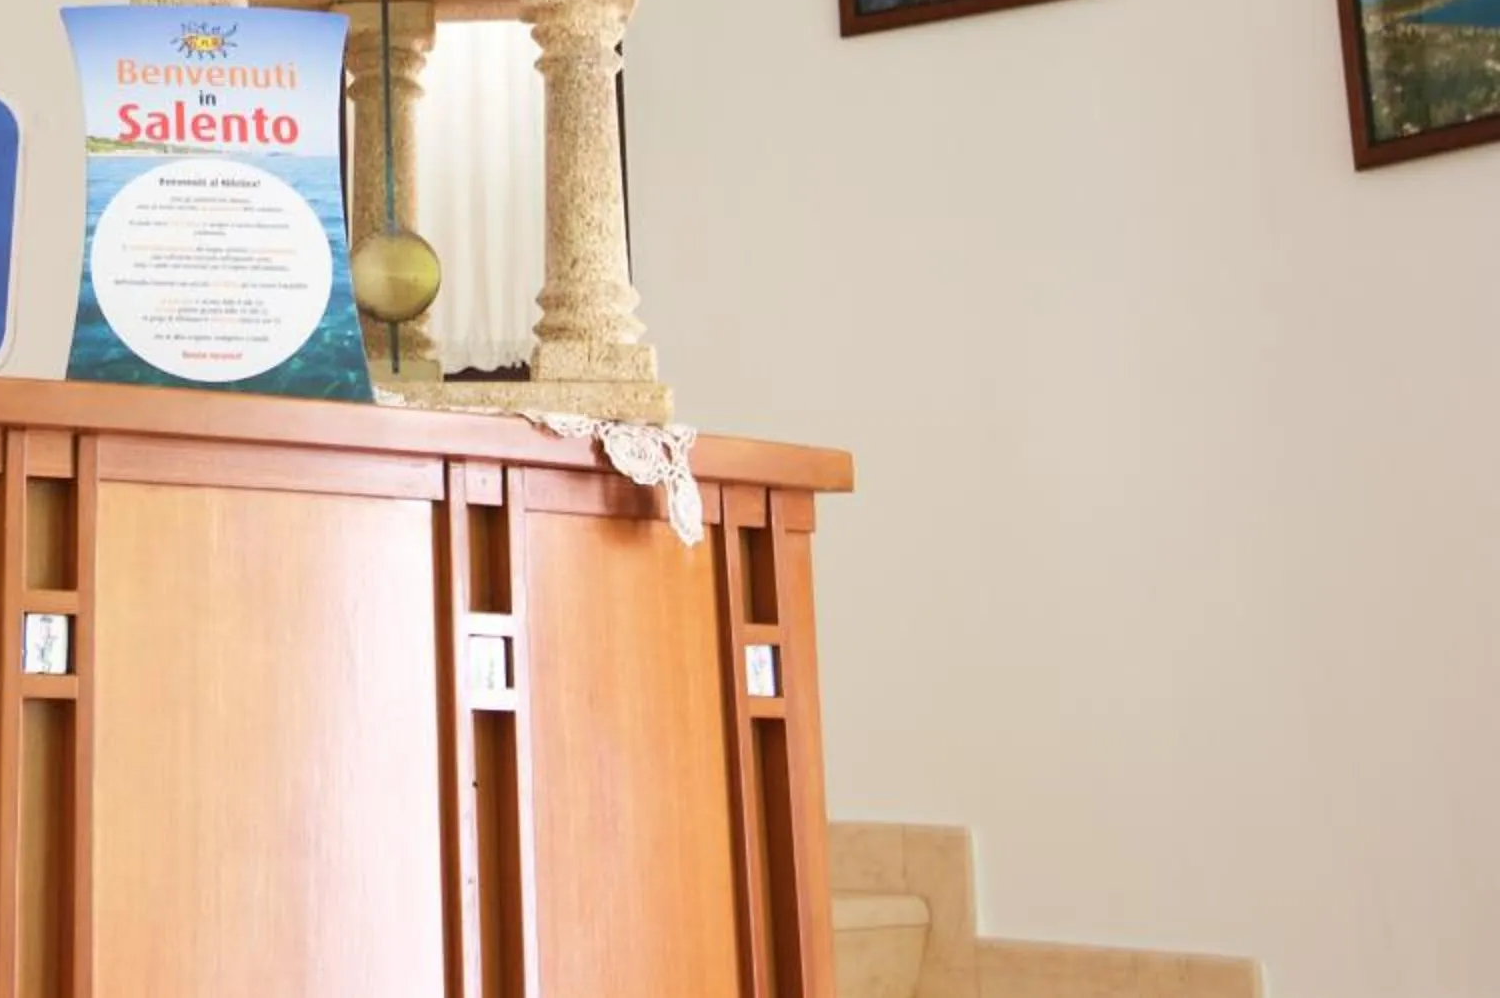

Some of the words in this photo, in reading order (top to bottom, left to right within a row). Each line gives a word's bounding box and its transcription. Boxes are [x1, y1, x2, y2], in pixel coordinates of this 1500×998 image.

[116, 57, 298, 90] Benvenuti
[198, 90, 217, 106] in
[117, 100, 300, 145] Salento
